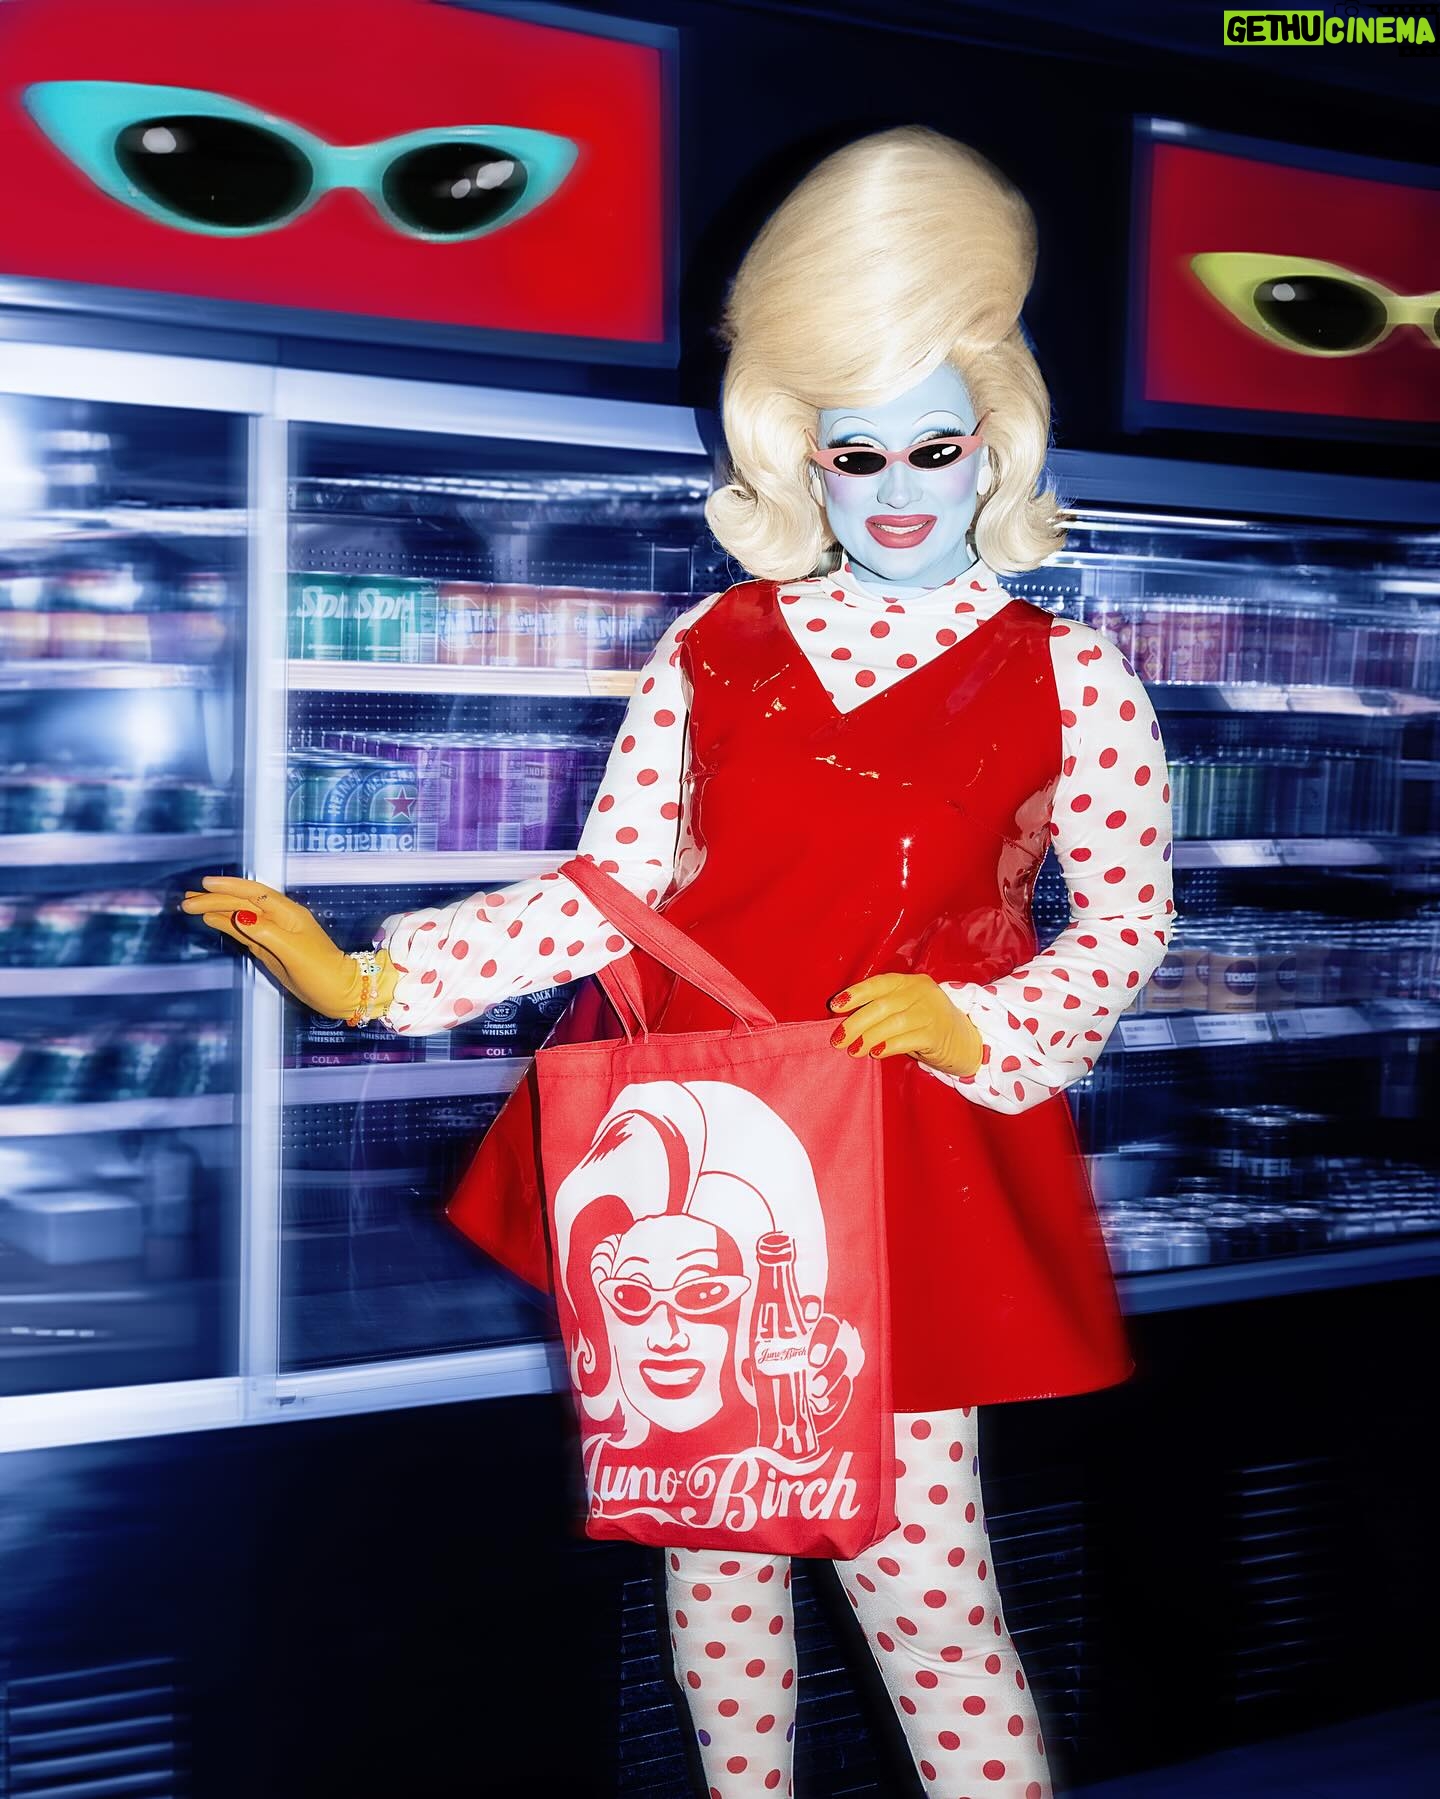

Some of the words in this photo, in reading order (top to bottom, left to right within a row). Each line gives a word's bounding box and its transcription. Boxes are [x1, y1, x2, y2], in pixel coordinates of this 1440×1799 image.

[360, 1030, 398, 1041] WHISKEY
[481, 1028, 518, 1036] WHISKEY
[303, 1034, 347, 1044] WHISKEY
[363, 1051, 391, 1062] COLA
[486, 1047, 513, 1057] COLA
[311, 1055, 340, 1065] COLA
